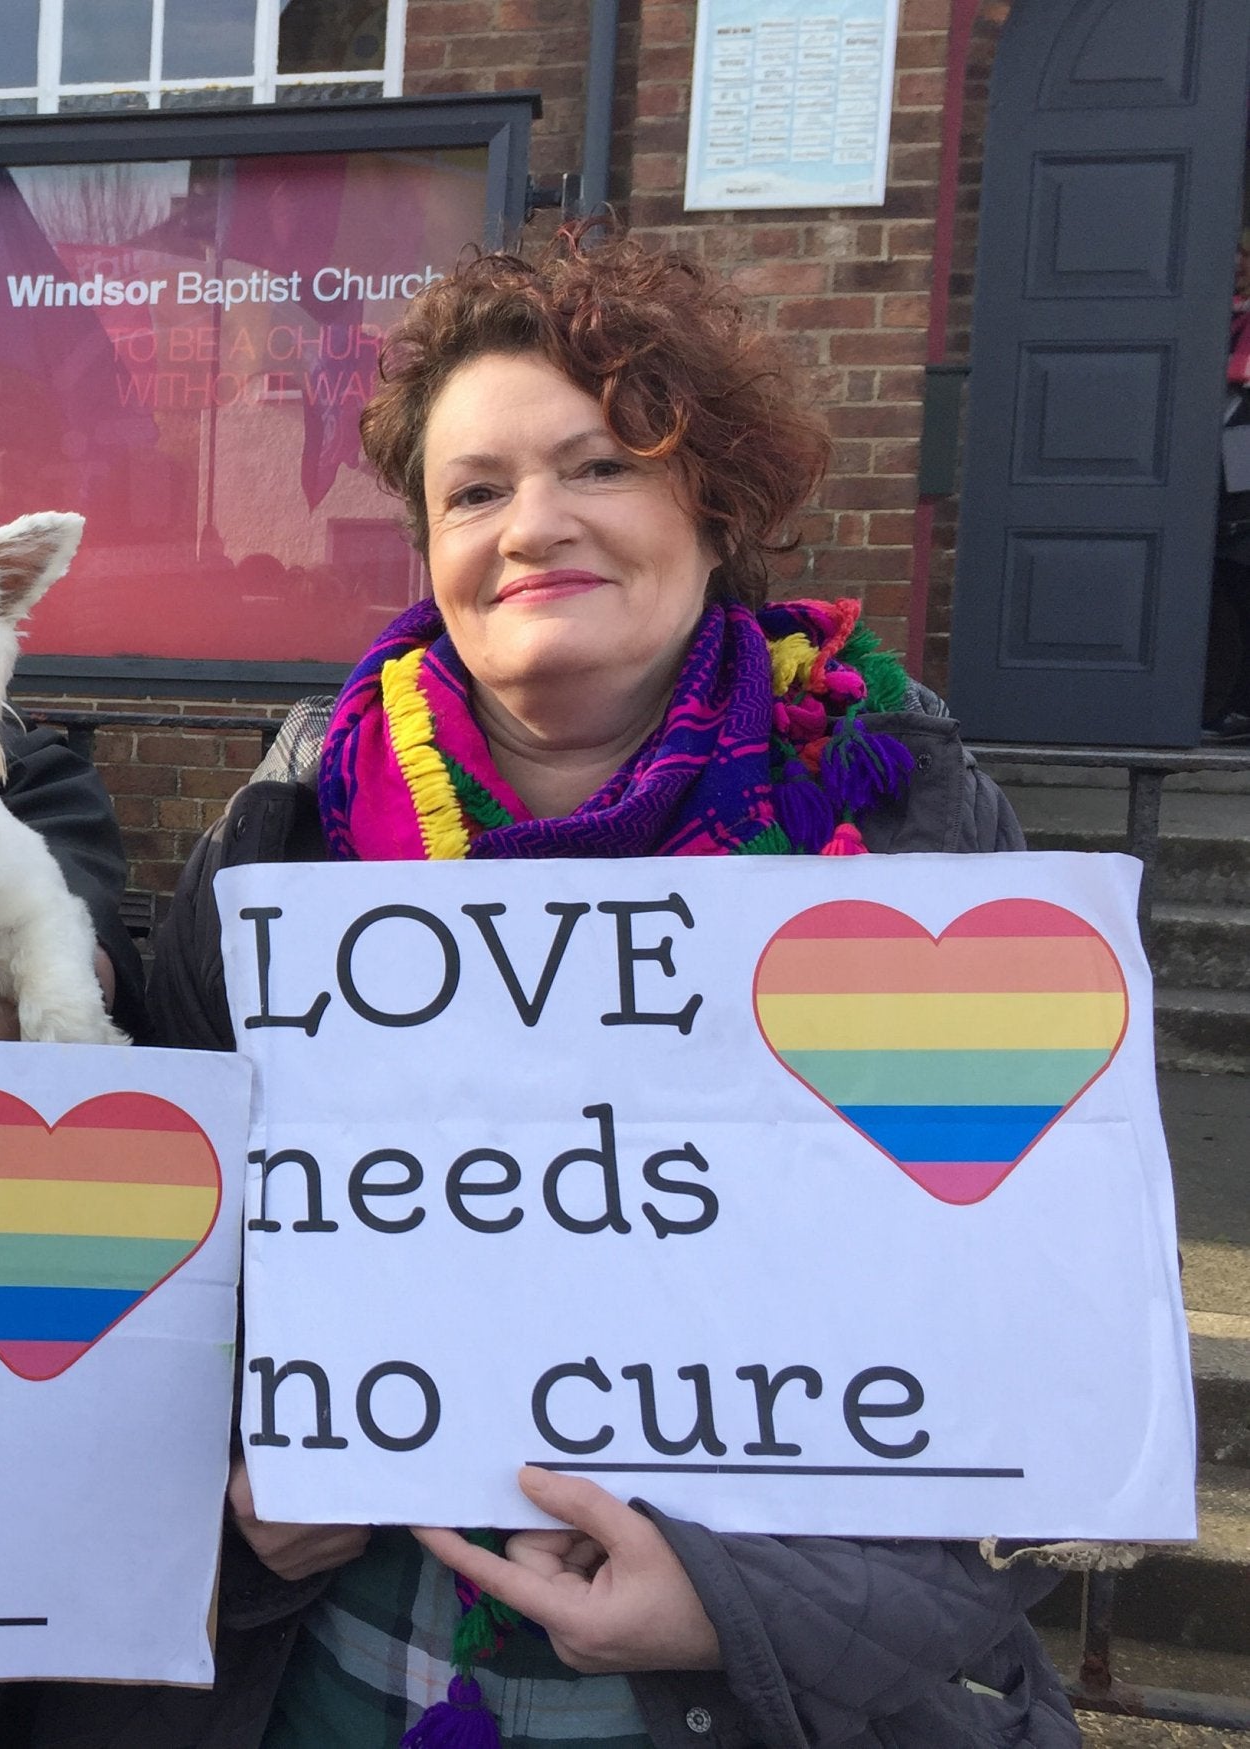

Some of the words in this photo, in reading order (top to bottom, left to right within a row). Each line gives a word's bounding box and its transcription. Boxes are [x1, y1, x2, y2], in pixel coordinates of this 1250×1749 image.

[7, 274, 167, 307] Windsor
[176, 270, 302, 312] Baptist
[111, 327, 155, 363] TO
[169, 326, 220, 362] BE
[229, 325, 256, 361] A
[116, 372, 295, 408] WITHOUT
[240, 892, 704, 1036] LOVE
[248, 1103, 719, 1240] needs
[248, 1356, 442, 1453] no
[531, 1356, 931, 1459] cure
